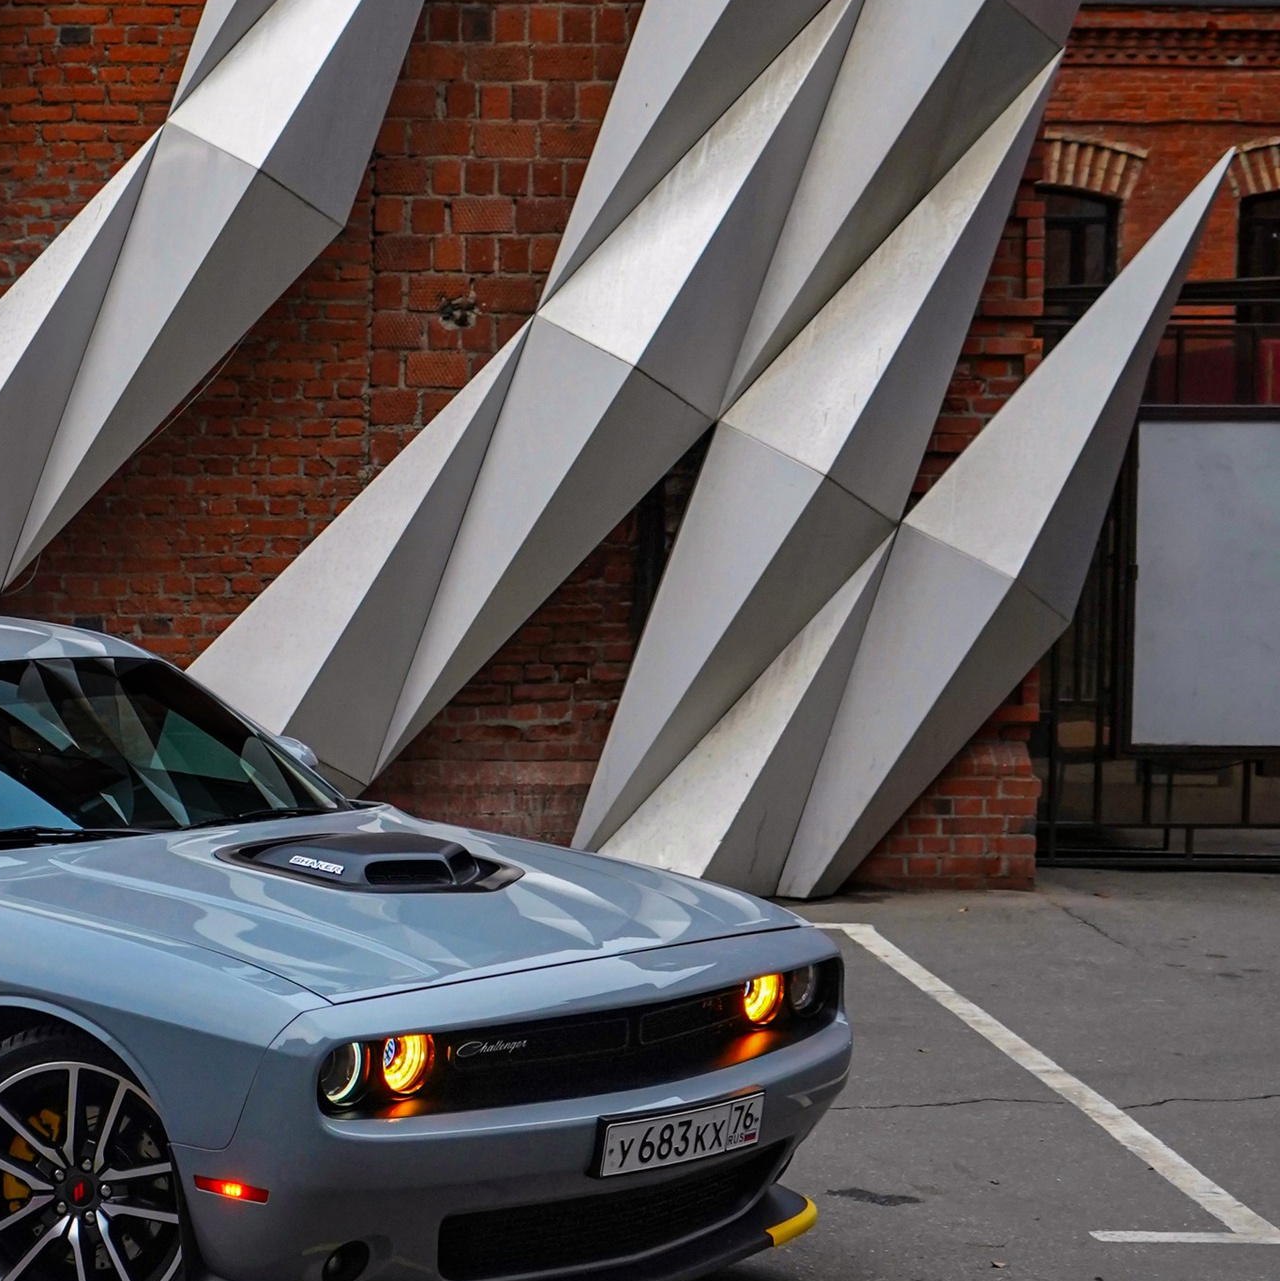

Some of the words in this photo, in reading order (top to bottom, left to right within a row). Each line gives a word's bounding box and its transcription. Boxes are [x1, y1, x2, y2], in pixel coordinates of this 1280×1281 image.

[289, 855, 344, 875] SHAKER
[456, 1040, 527, 1057] Challenger
[728, 1131, 745, 1145] RUS
